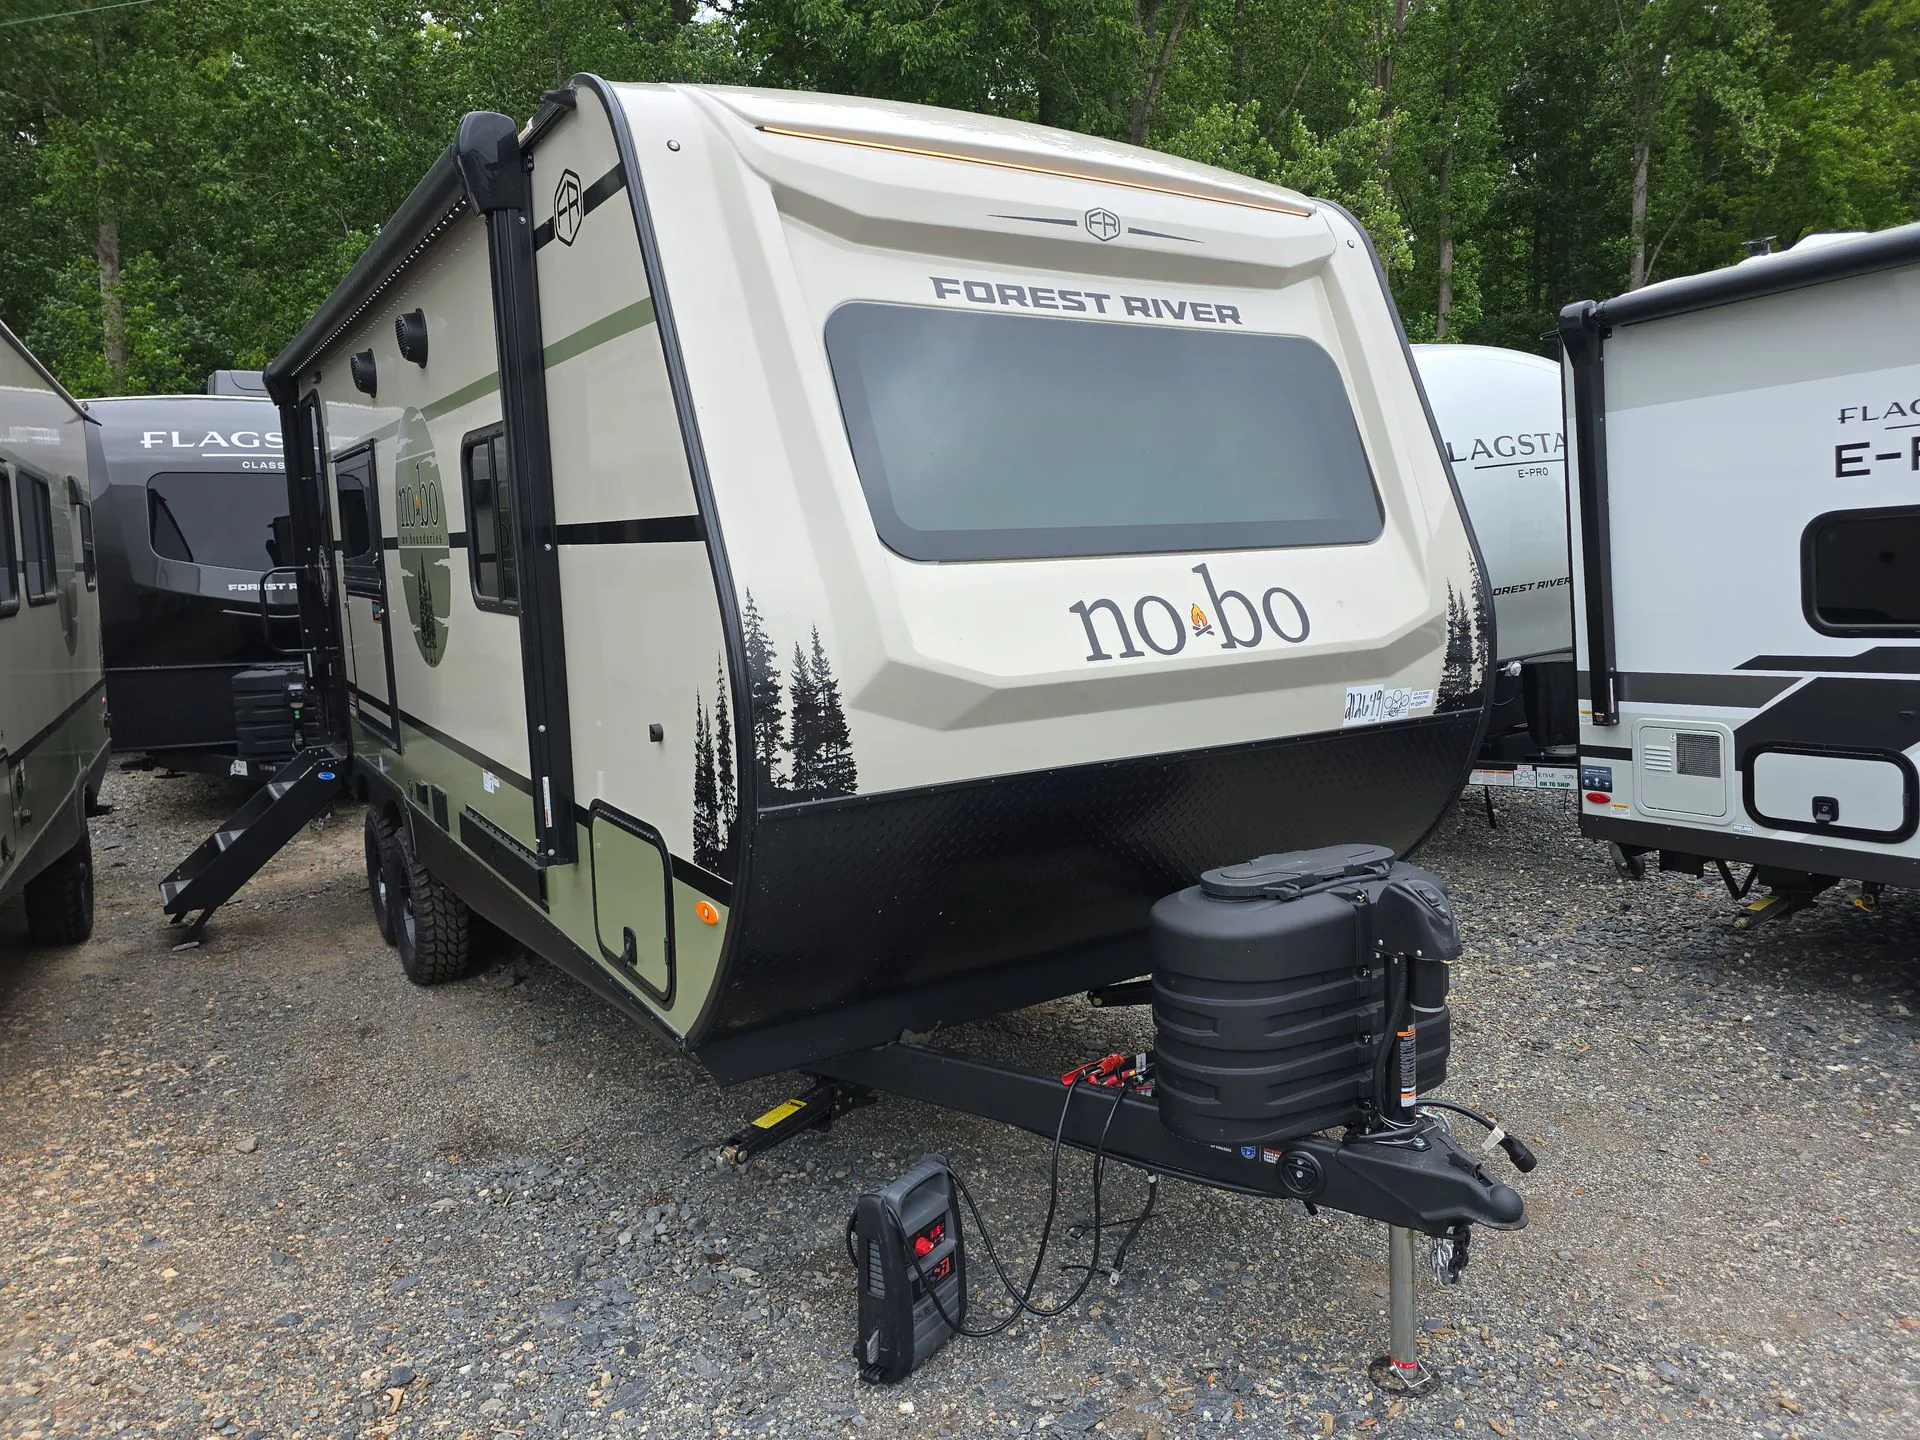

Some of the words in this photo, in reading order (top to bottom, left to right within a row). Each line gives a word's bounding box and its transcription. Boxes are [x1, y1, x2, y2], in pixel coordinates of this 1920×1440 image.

[929, 276, 1111, 314] FOREST
[1120, 295, 1243, 325] RIVER
[1835, 436, 1920, 478] E-
[242, 461, 285, 469] CLASS
[1518, 467, 1550, 479] E-PRO
[1491, 582, 1536, 596] OREST
